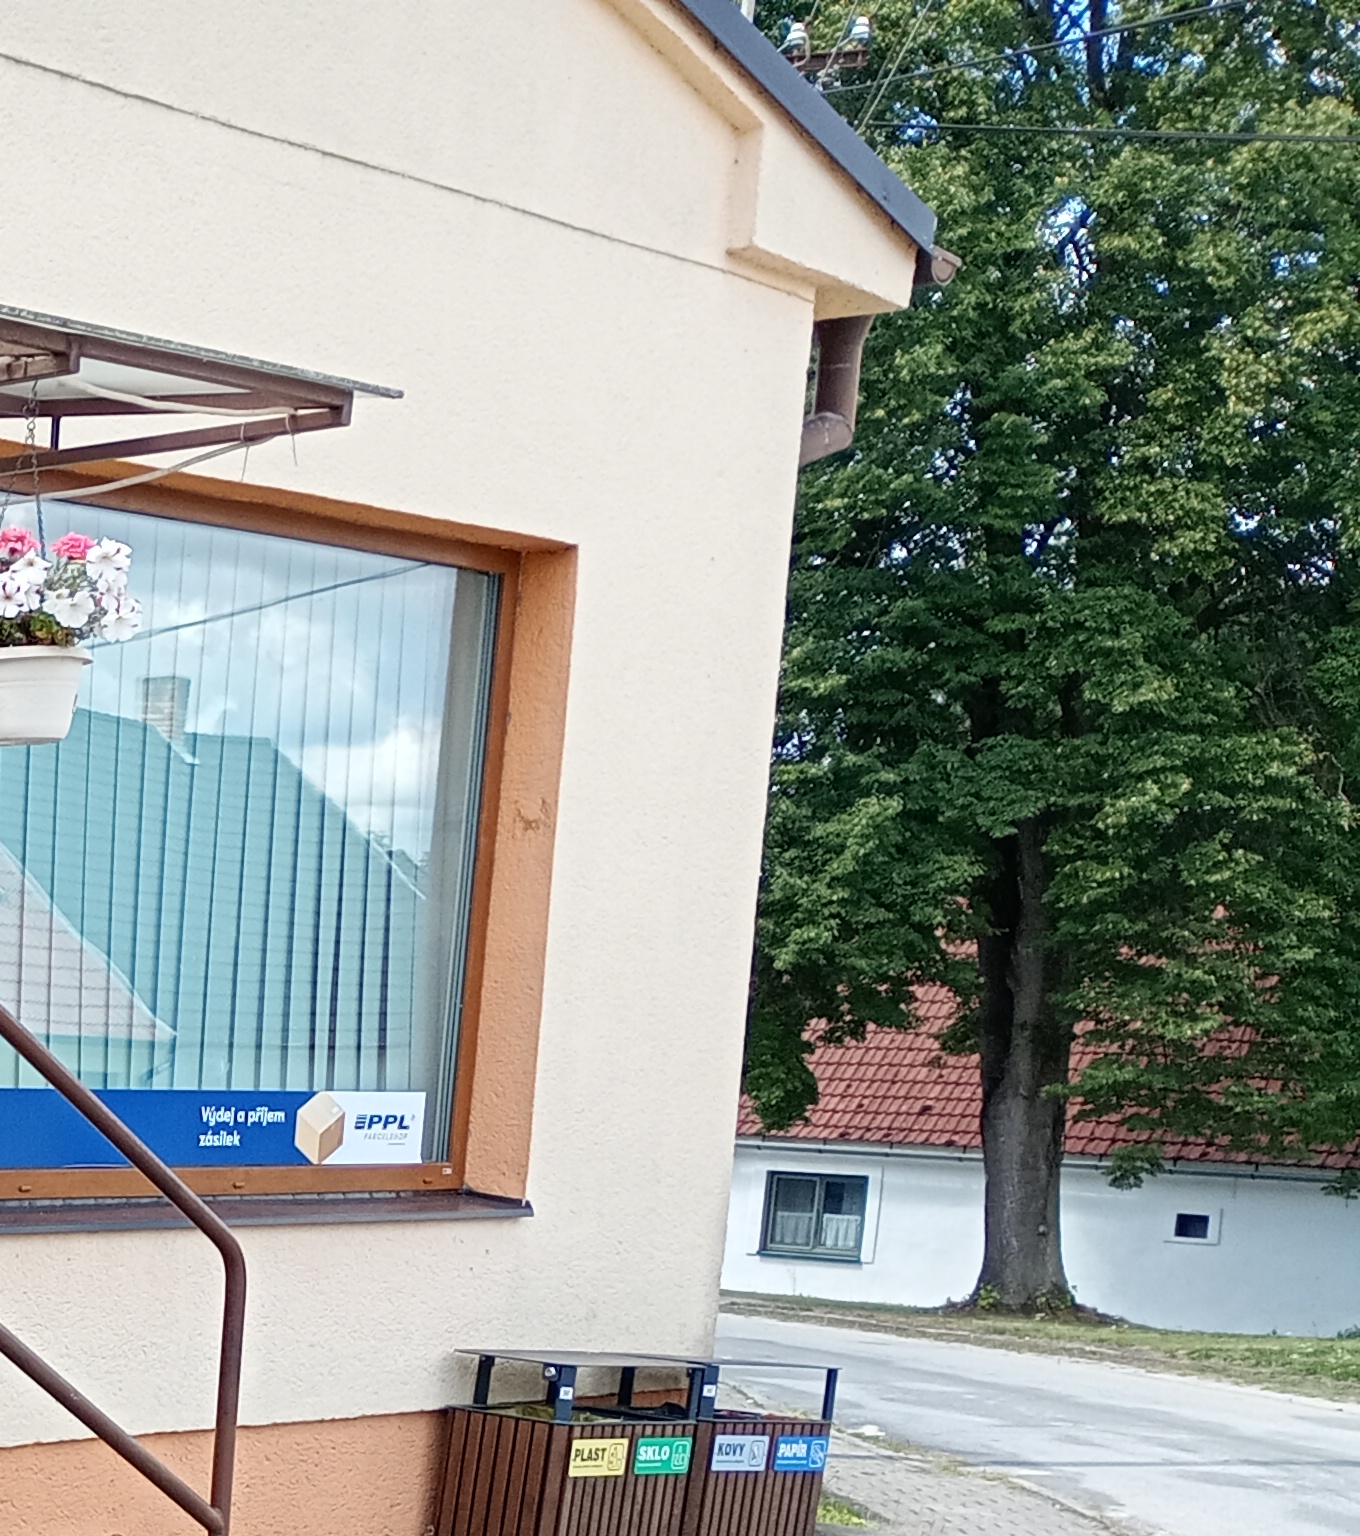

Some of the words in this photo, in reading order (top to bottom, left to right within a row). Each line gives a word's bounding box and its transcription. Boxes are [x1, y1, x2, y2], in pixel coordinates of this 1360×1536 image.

[201, 1106, 236, 1127] Výdej
[236, 1110, 245, 1123] a
[247, 1106, 285, 1127] příjem
[366, 1114, 410, 1130] PPL
[198, 1129, 241, 1147] zásilek
[573, 1447, 607, 1462] PLAST
[638, 1445, 670, 1461] SKLO
[717, 1442, 746, 1457] KOVY
[777, 1439, 807, 1458] PAPÍR
